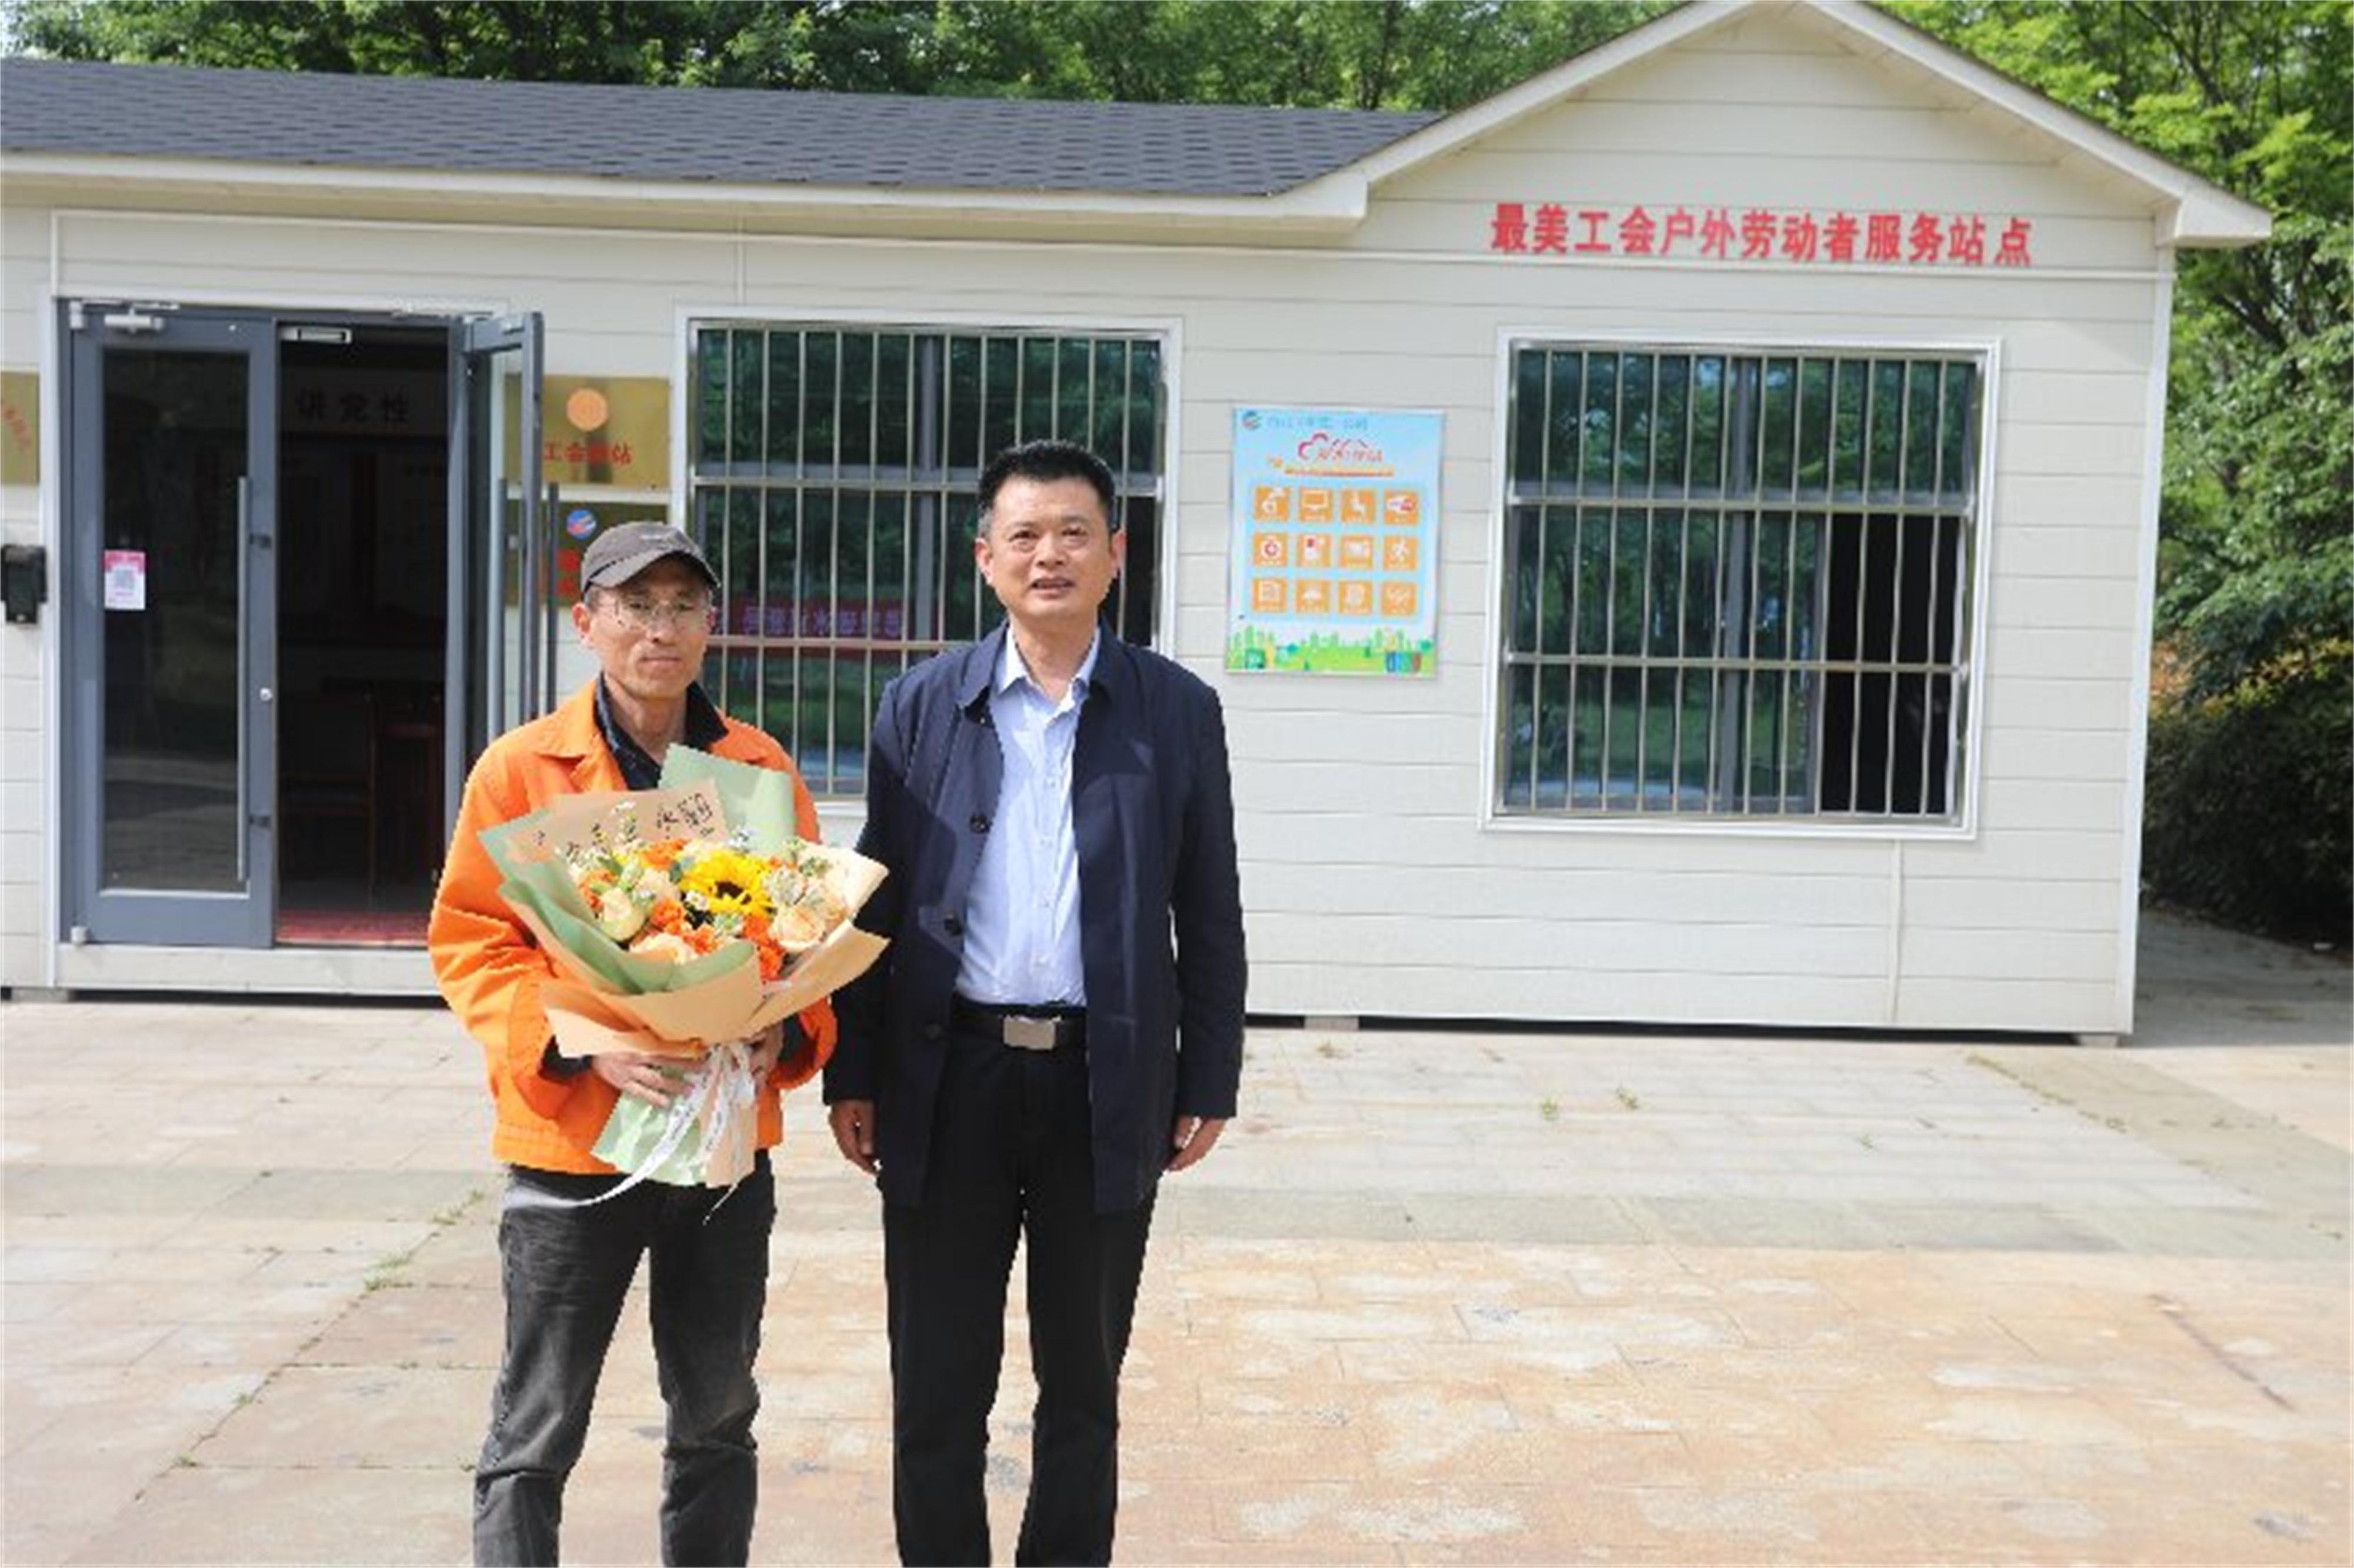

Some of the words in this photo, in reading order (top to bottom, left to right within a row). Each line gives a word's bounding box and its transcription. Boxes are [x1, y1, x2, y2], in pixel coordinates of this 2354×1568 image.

[1490, 202, 2033, 266] 最美工会户外劳动者服务站点
